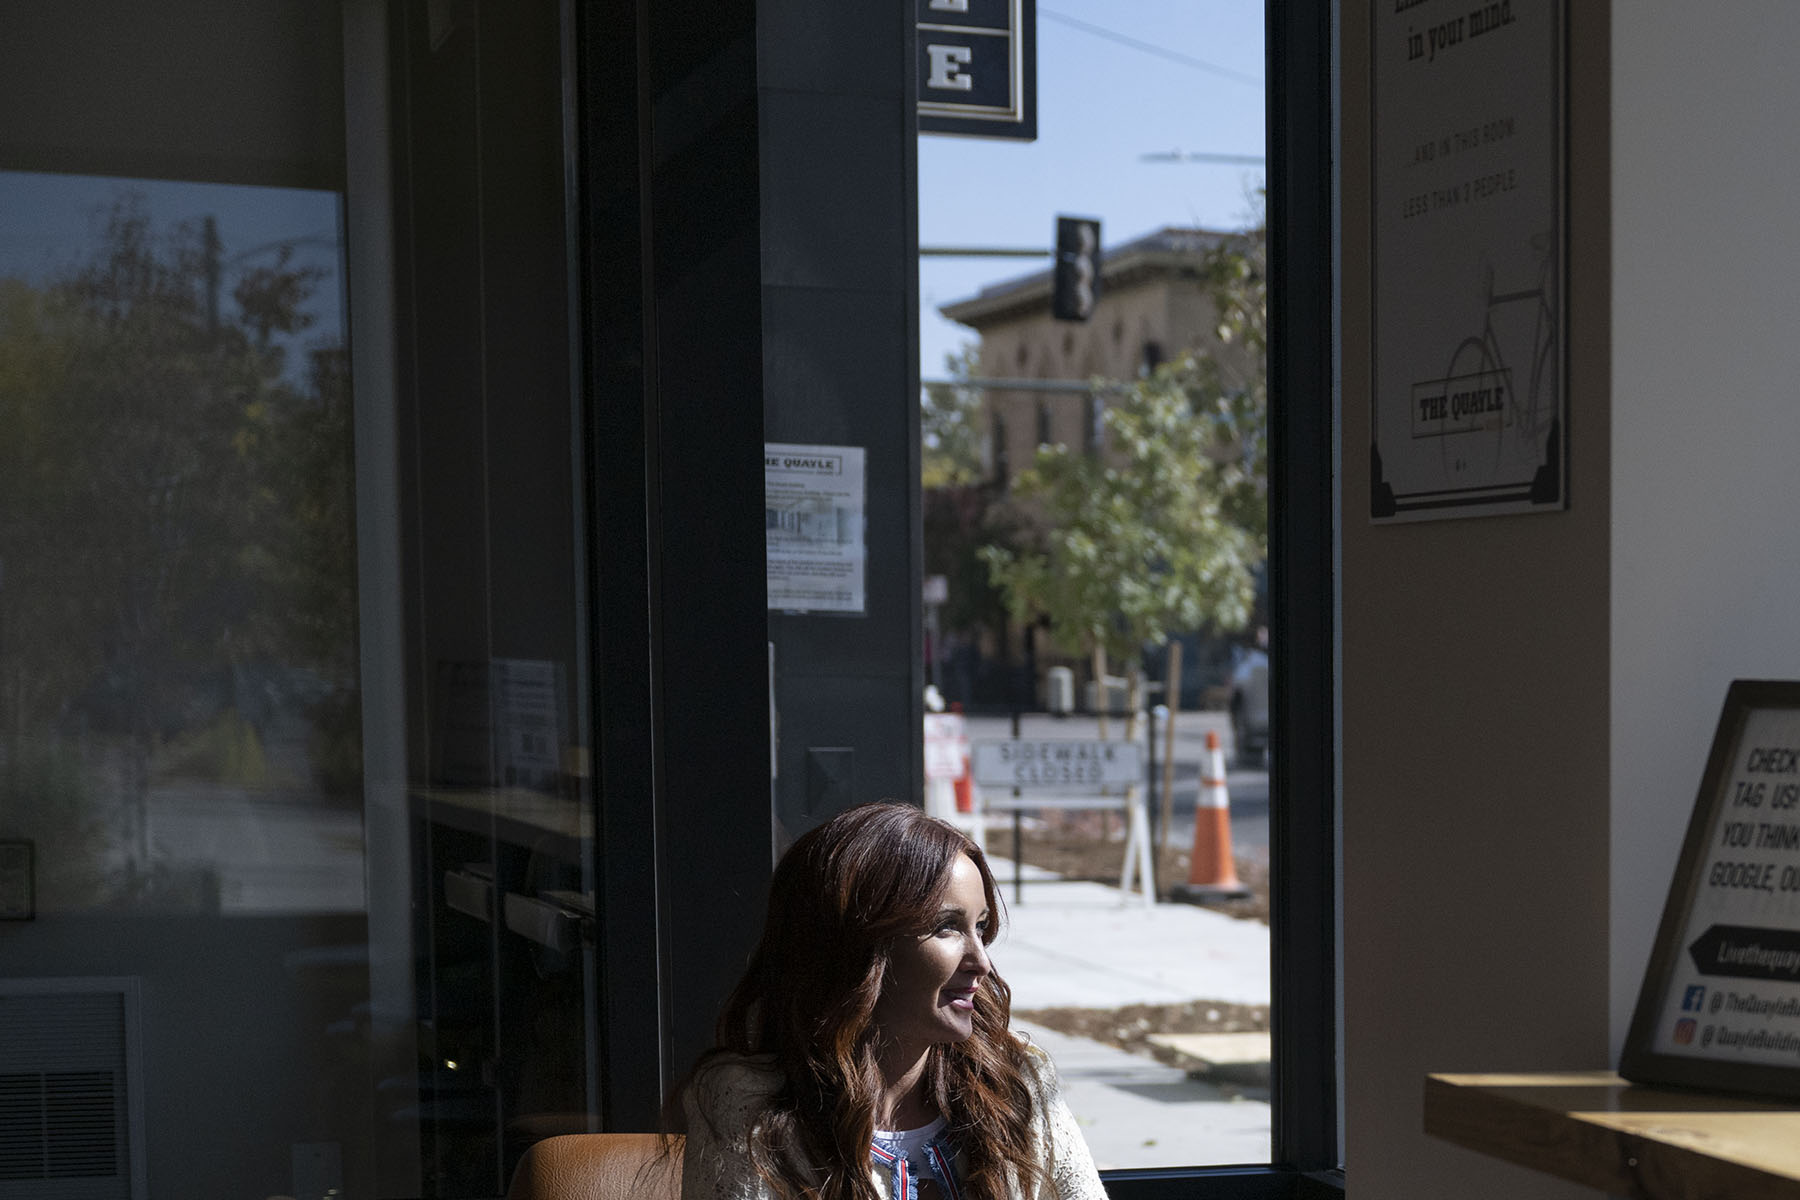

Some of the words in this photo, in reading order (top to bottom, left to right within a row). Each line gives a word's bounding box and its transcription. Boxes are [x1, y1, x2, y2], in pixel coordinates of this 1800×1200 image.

[1408, 26, 1424, 61] in
[1428, 17, 1464, 62] your
[1469, 0, 1516, 38] mind.
[1454, 127, 1481, 153] THIS
[1402, 193, 1428, 218] LESS
[1432, 186, 1461, 209] THAN
[1420, 395, 1448, 421] THE
[1451, 387, 1504, 421] QUAYLE
[783, 458, 834, 470] QUAYLE
[1000, 742, 1115, 761] SIDEWALK
[1015, 762, 1103, 783] CLOSED
[1733, 782, 1767, 808] TAG
[1722, 822, 1755, 849] YOU
[1709, 861, 1776, 897] GOOGLE,
